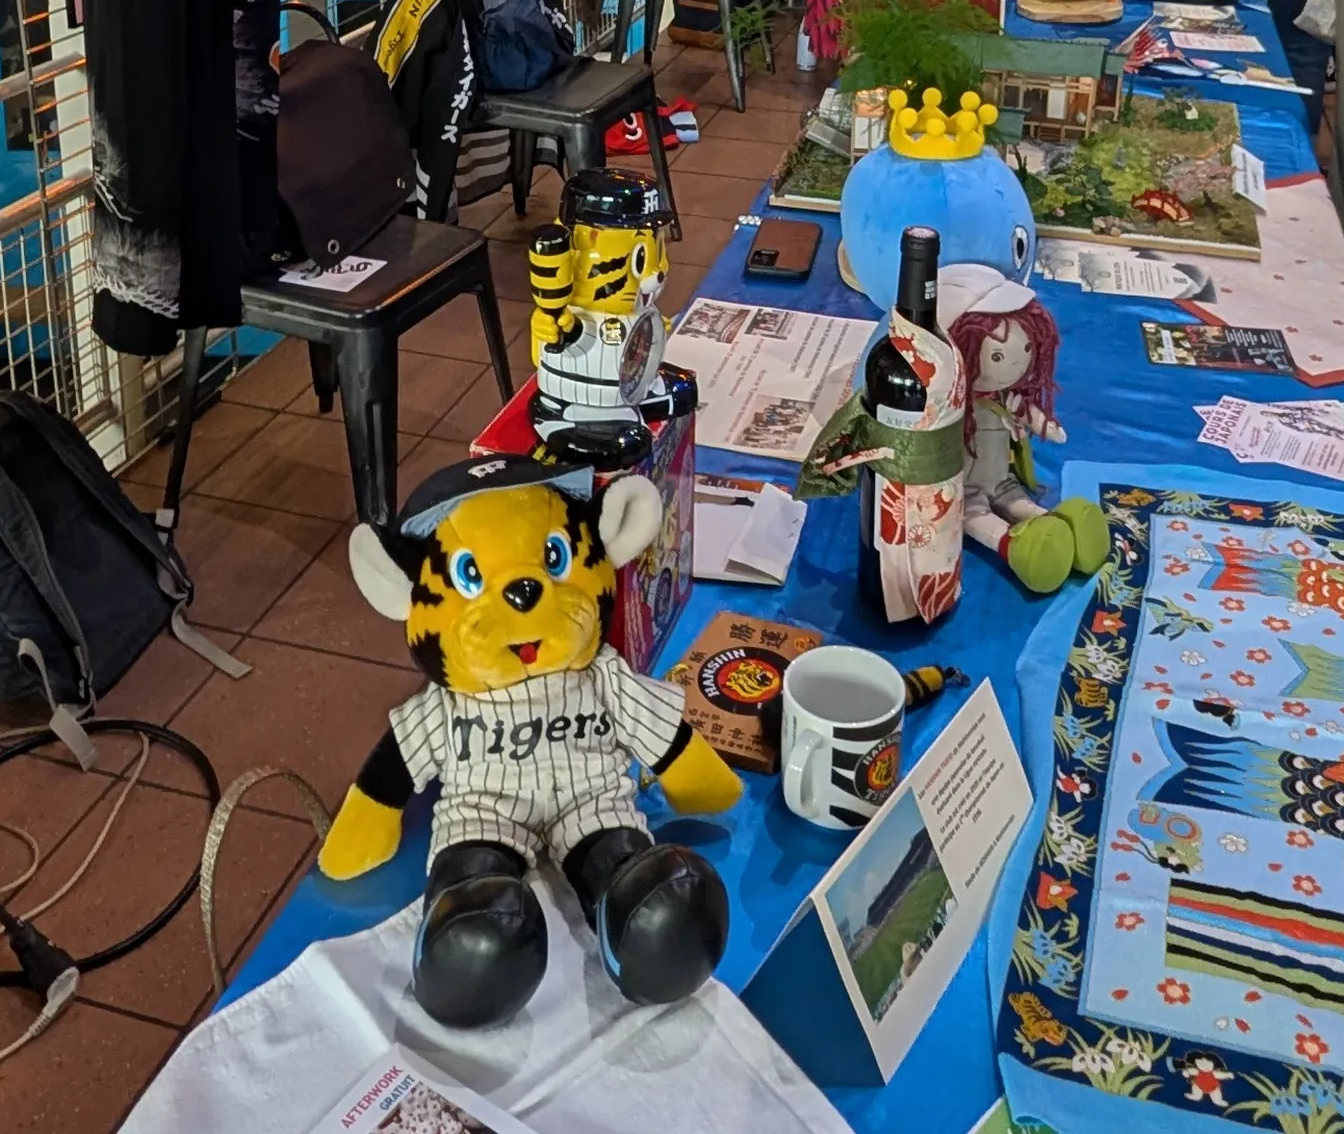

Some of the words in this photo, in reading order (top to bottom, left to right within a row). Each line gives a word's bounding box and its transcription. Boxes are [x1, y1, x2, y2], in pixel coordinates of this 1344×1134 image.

[1200, 410, 1228, 440] COURS
[1218, 399, 1235, 410] DE
[1213, 402, 1248, 444] JAPONAIS
[704, 648, 747, 697] HANSHIN
[452, 711, 612, 761] Tigers
[340, 1065, 404, 1129] AFTERWORK
[379, 1074, 416, 1112] GRATUIT
